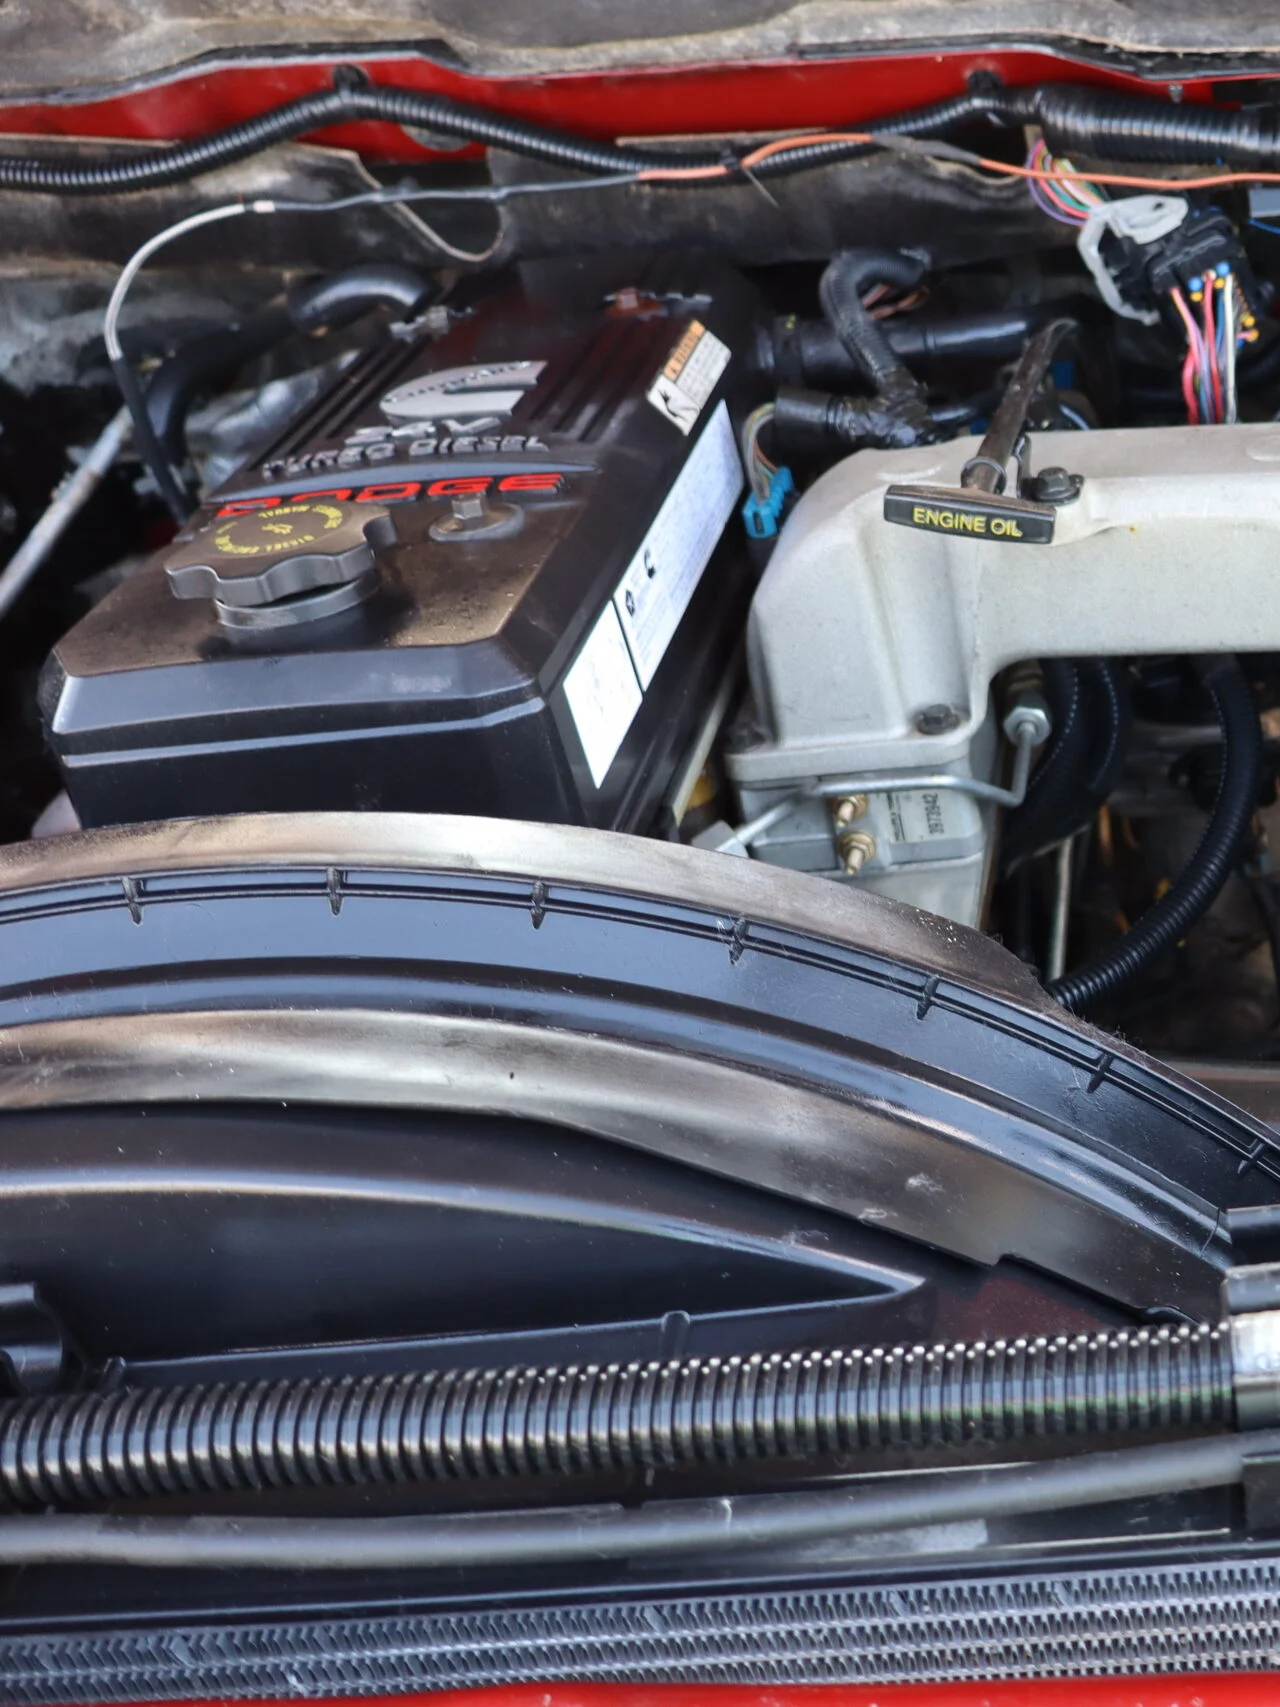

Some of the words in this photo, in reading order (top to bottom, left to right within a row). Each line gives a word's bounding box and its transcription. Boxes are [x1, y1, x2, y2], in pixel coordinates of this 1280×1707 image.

[408, 434, 549, 457] DIESEL
[913, 507, 986, 534] ENGINE
[989, 516, 1023, 539] OIL
